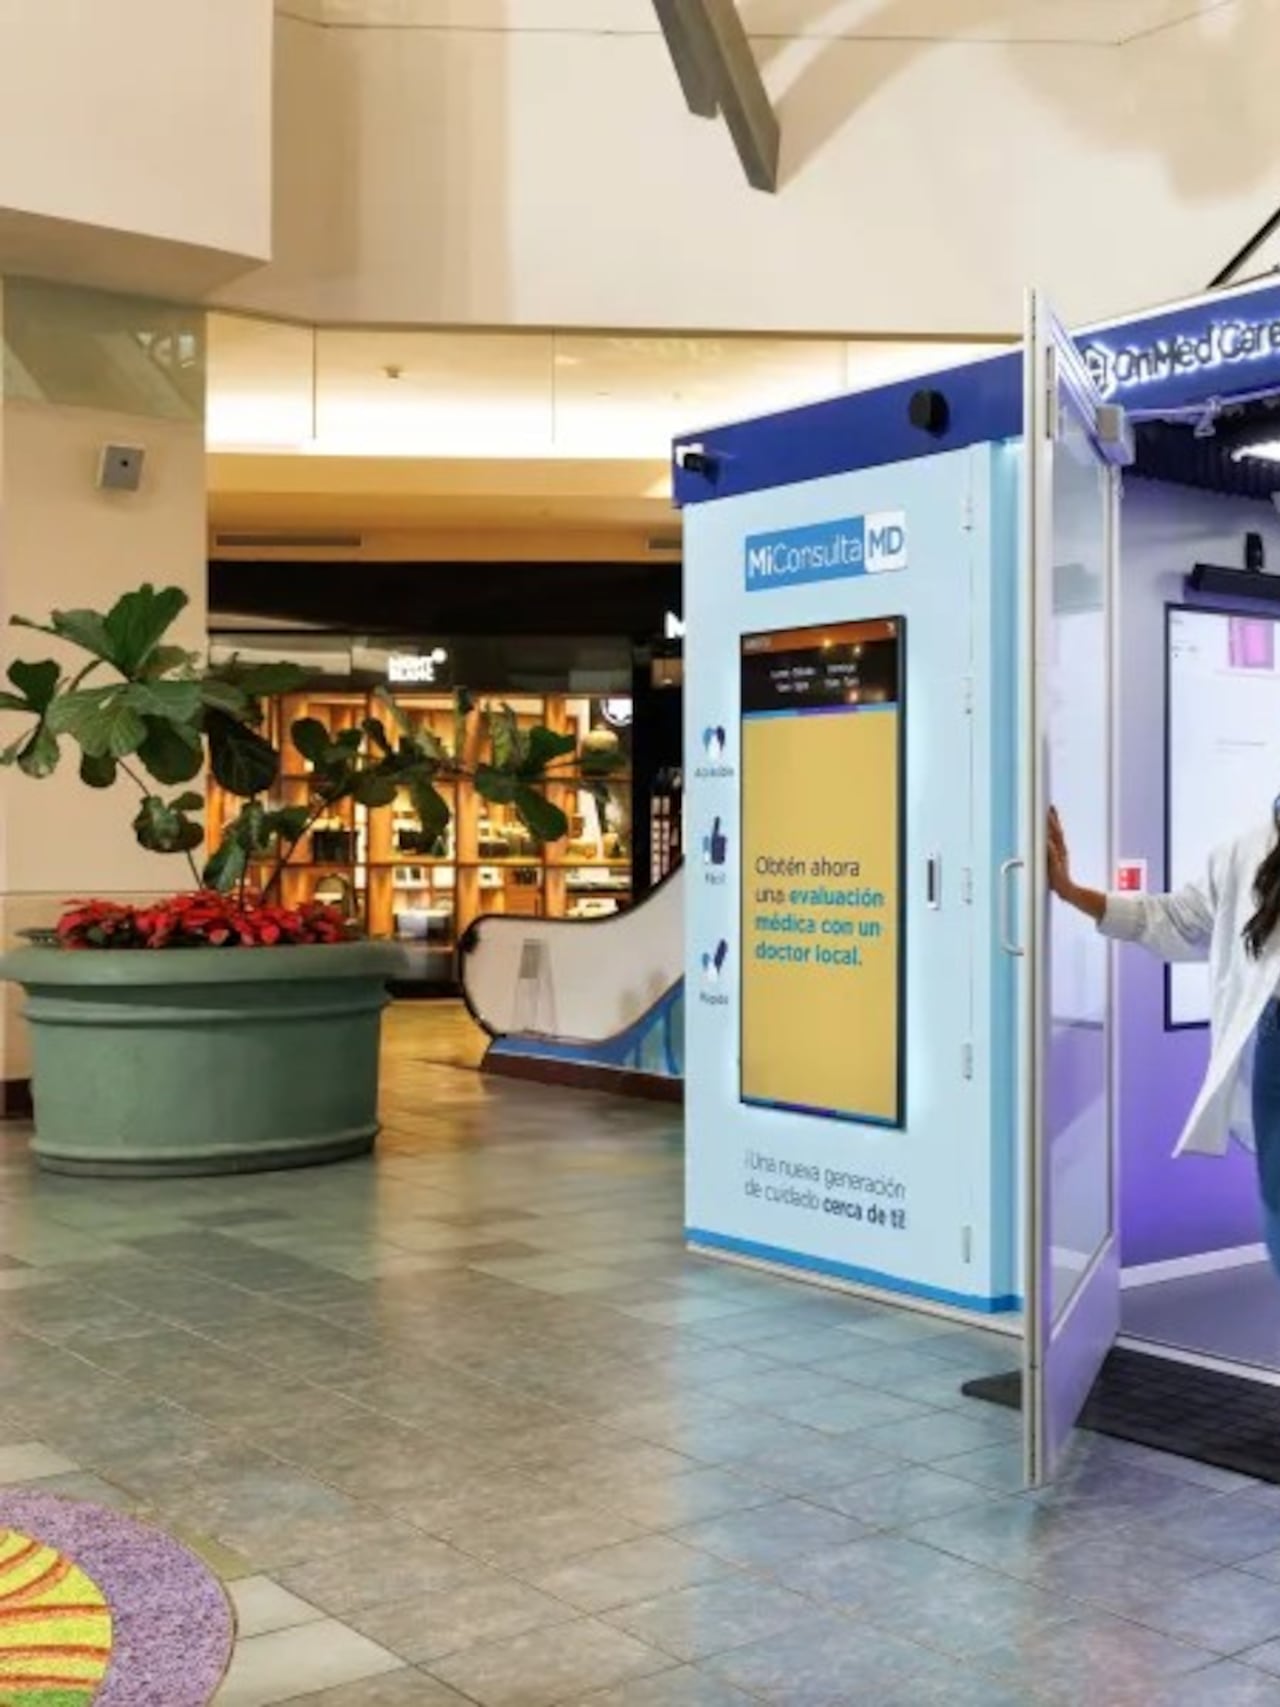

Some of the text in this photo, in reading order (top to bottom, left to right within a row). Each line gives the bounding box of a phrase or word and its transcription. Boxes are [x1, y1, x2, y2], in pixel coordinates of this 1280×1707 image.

[1113, 325, 1212, 382] OnMed
[755, 856, 860, 877] Obtén ahora
[755, 886, 885, 908] una evaluación
[755, 913, 881, 937] médica con un
[755, 943, 862, 966] doctor local.
[779, 1159, 820, 1182] nueva
[824, 1168, 906, 1199] generación
[744, 1178, 762, 1198] de
[765, 1184, 820, 1210] cuidado
[822, 1197, 863, 1221] cerca
[867, 1203, 886, 1226] de
